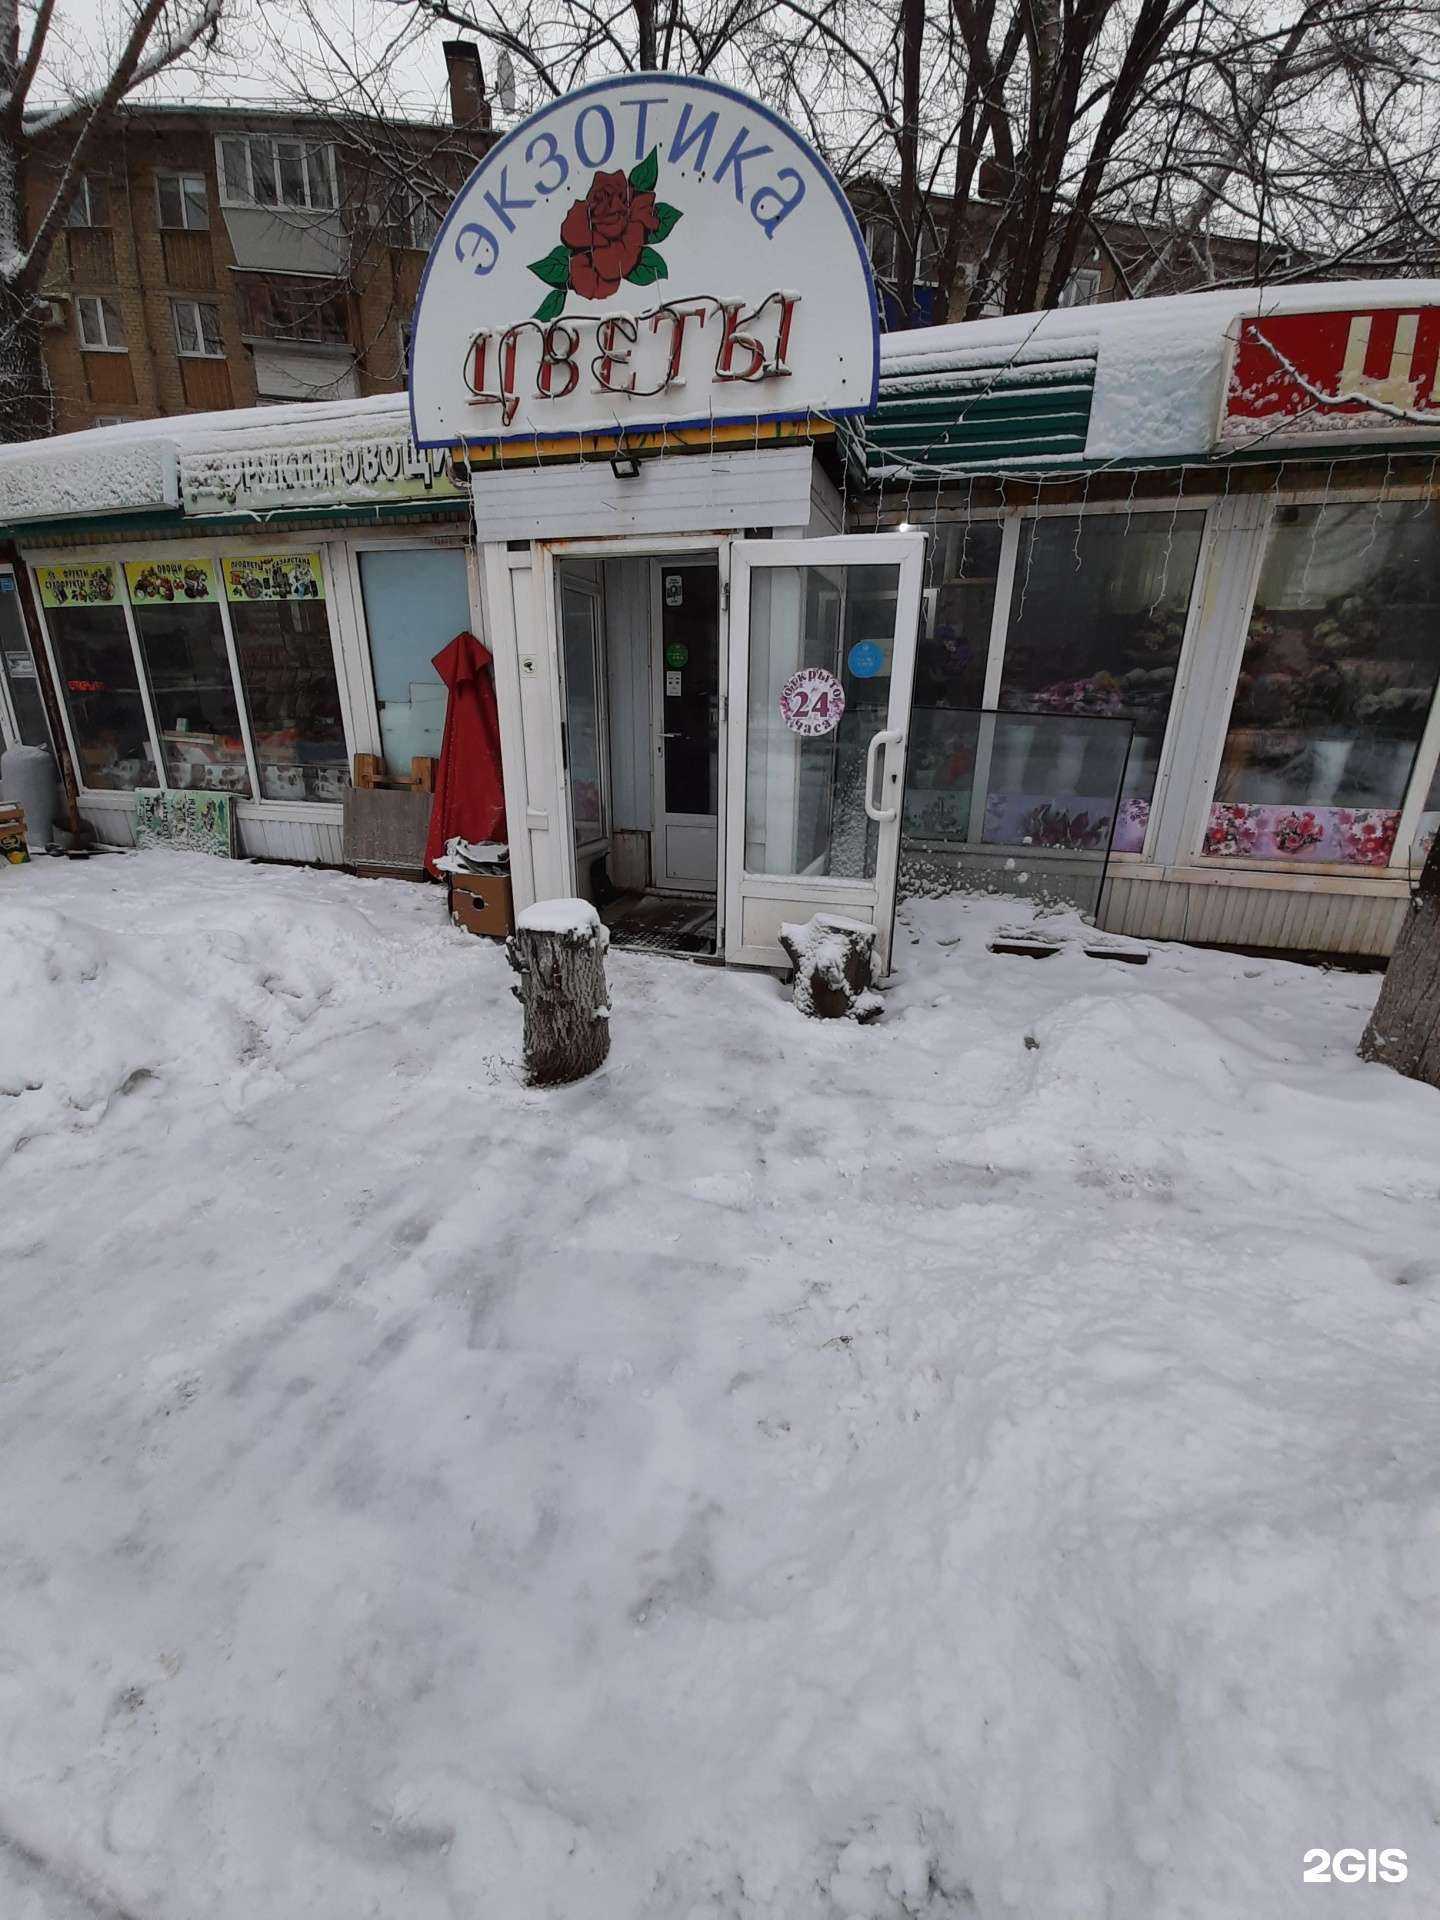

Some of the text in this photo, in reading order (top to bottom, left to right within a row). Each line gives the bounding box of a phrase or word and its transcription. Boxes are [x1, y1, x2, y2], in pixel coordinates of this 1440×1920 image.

[463, 290, 802, 426] ЦВЕТЫ
[157, 563, 183, 575] ОВОЩИ
[792, 691, 830, 718] 24
